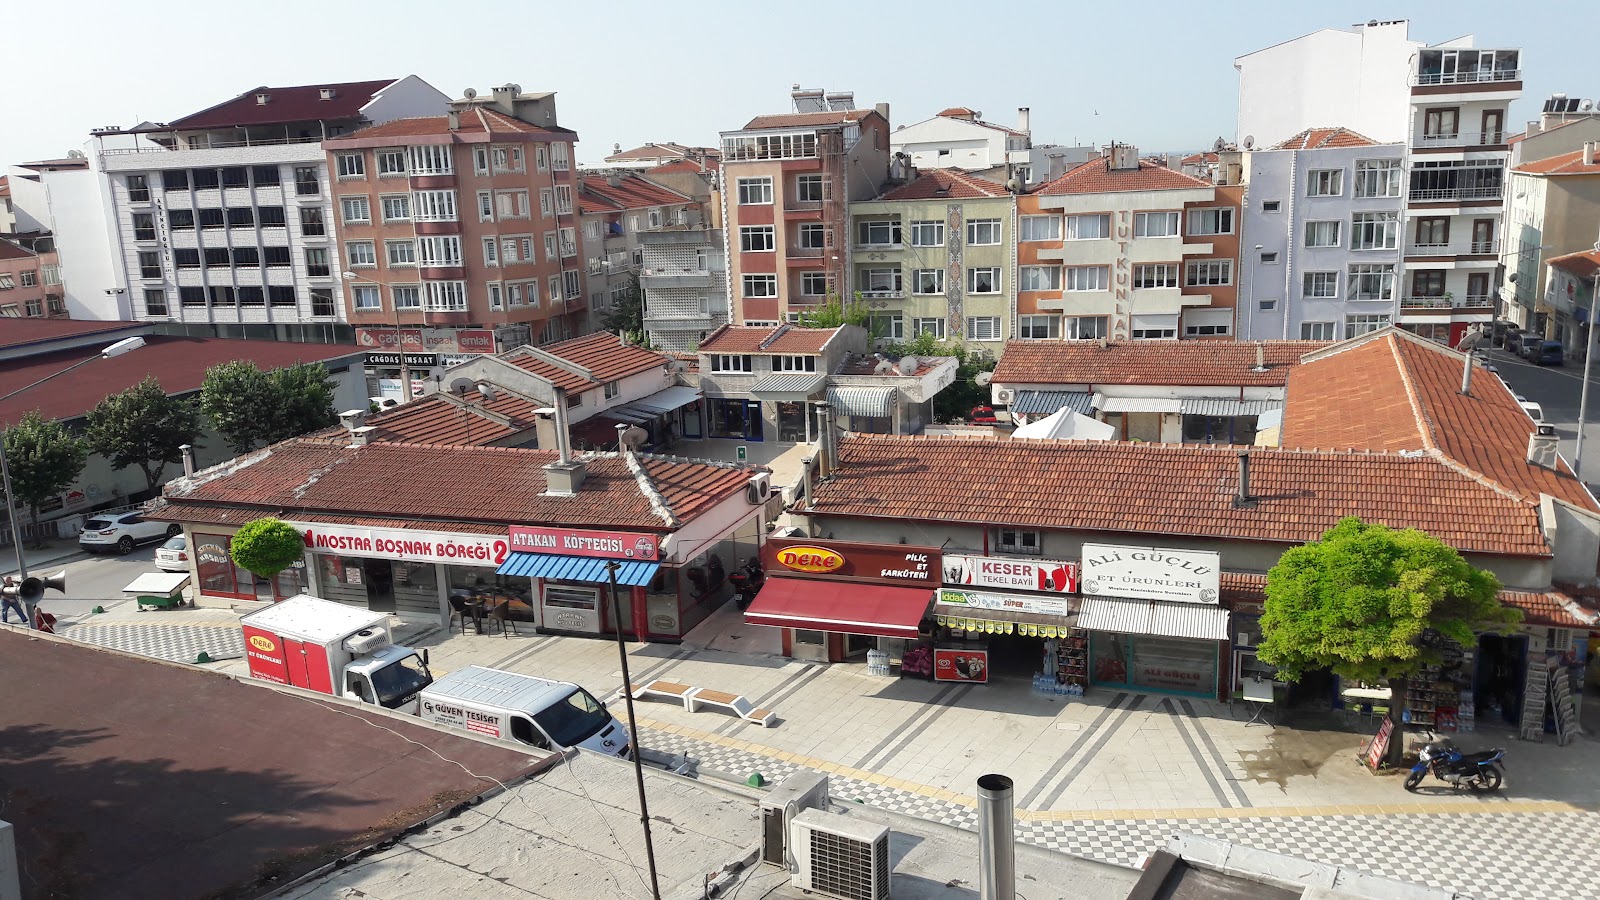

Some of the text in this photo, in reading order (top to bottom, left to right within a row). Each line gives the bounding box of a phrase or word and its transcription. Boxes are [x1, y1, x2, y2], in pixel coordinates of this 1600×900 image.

[461, 336, 490, 346] emlak
[513, 533, 557, 547] ATAKAN
[564, 533, 623, 552] KÖFTECİSİ
[317, 534, 508, 565] MOSTAR BOŞNAK BÖREĞİ 2
[783, 552, 835, 568] DERE
[905, 553, 928, 562] PİLİÇ
[1088, 551, 1211, 576] ALİ GÜÇLÜ
[880, 569, 928, 579] ŞARKÜTERİ
[982, 562, 1033, 577] KESER
[983, 575, 1009, 584] TEKEL
[1121, 576, 1202, 589] ÜRÜNLERİ
[942, 592, 965, 602] iddaa
[1003, 598, 1024, 608] SÜPER
[252, 637, 273, 650] DERE
[435, 704, 463, 717] GÜVEN
[465, 710, 500, 725] TESİSAT
